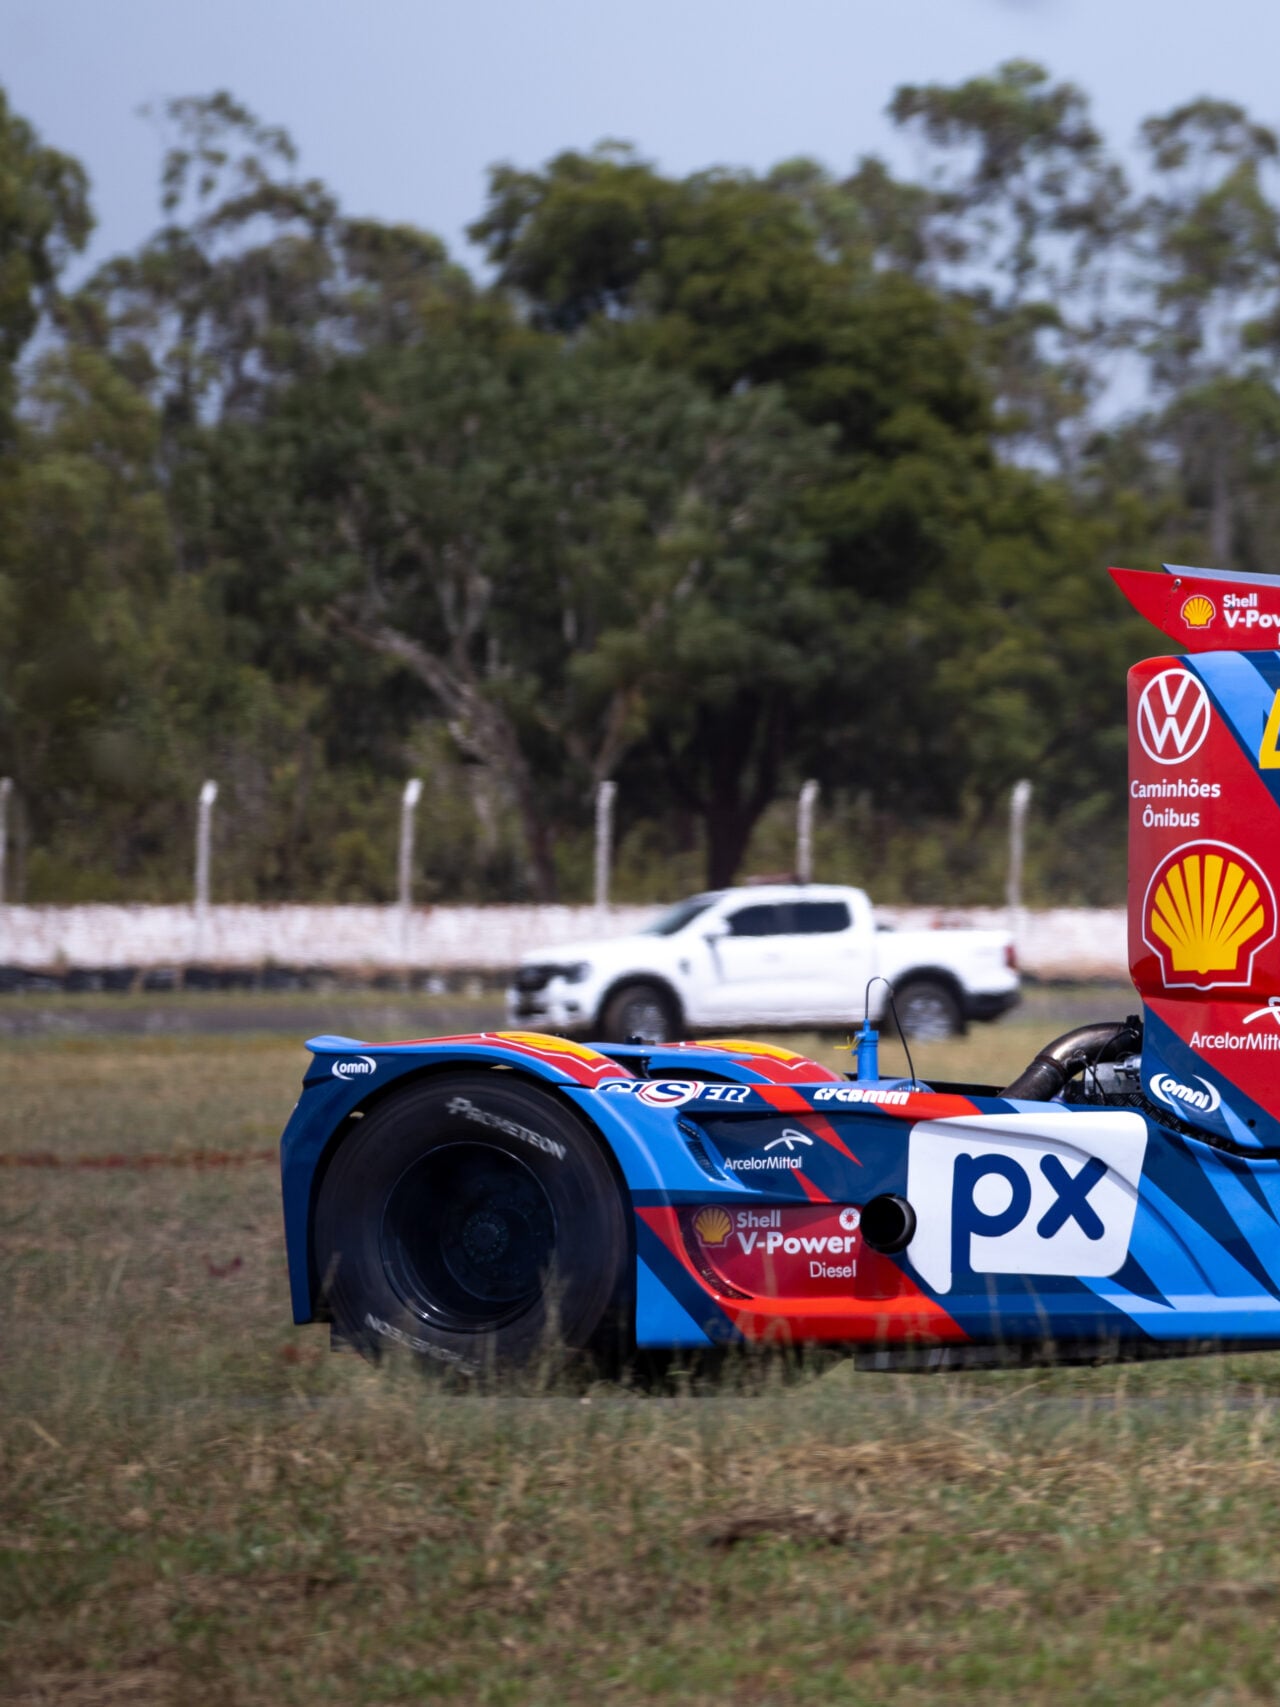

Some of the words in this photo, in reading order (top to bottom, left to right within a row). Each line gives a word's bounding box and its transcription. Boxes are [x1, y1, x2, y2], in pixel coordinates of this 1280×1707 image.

[1223, 593, 1258, 608] Shell
[1131, 778, 1221, 799] Caminhões
[1142, 803, 1200, 828] Ônibus
[1160, 1078, 1210, 1110] omni
[723, 1155, 803, 1171] ArcelorMittal
[736, 1210, 782, 1228] Shell
[951, 1153, 1108, 1273] px
[736, 1231, 857, 1255] V-Power
[809, 1261, 857, 1279] Diesel
